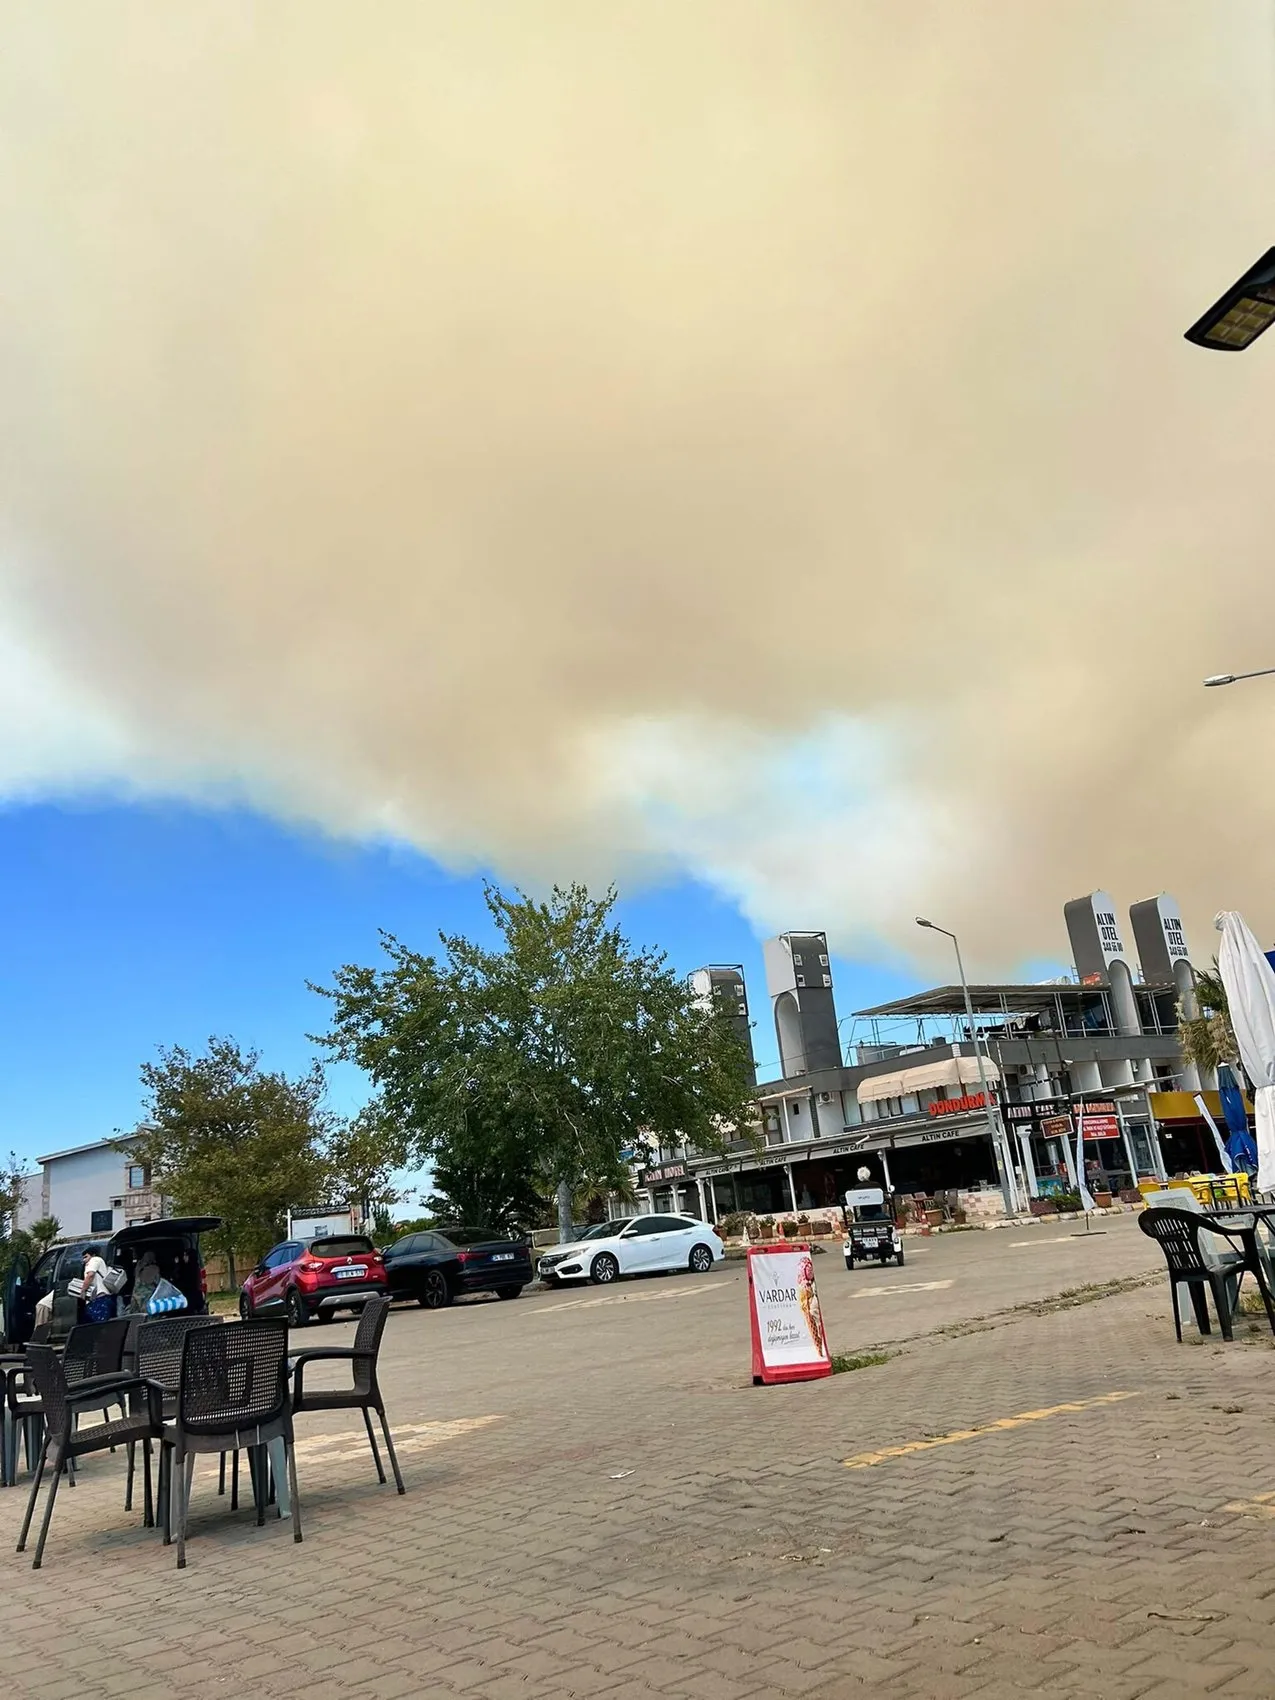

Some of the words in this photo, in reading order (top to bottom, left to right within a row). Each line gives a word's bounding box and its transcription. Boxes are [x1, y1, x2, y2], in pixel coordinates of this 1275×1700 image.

[1096, 913, 1115, 925] ALTIN
[1164, 919, 1182, 930] ALTIN
[1102, 927, 1118, 940] OTEL
[1168, 932, 1184, 945] OTEL
[921, 1133, 941, 1142] ALTIN
[942, 1129, 960, 1138] CAFE
[832, 1146, 849, 1154] ALTIN
[849, 1143, 865, 1152] CAFE
[759, 1288, 797, 1303] VARDAR
[767, 1319, 782, 1333] 1992
